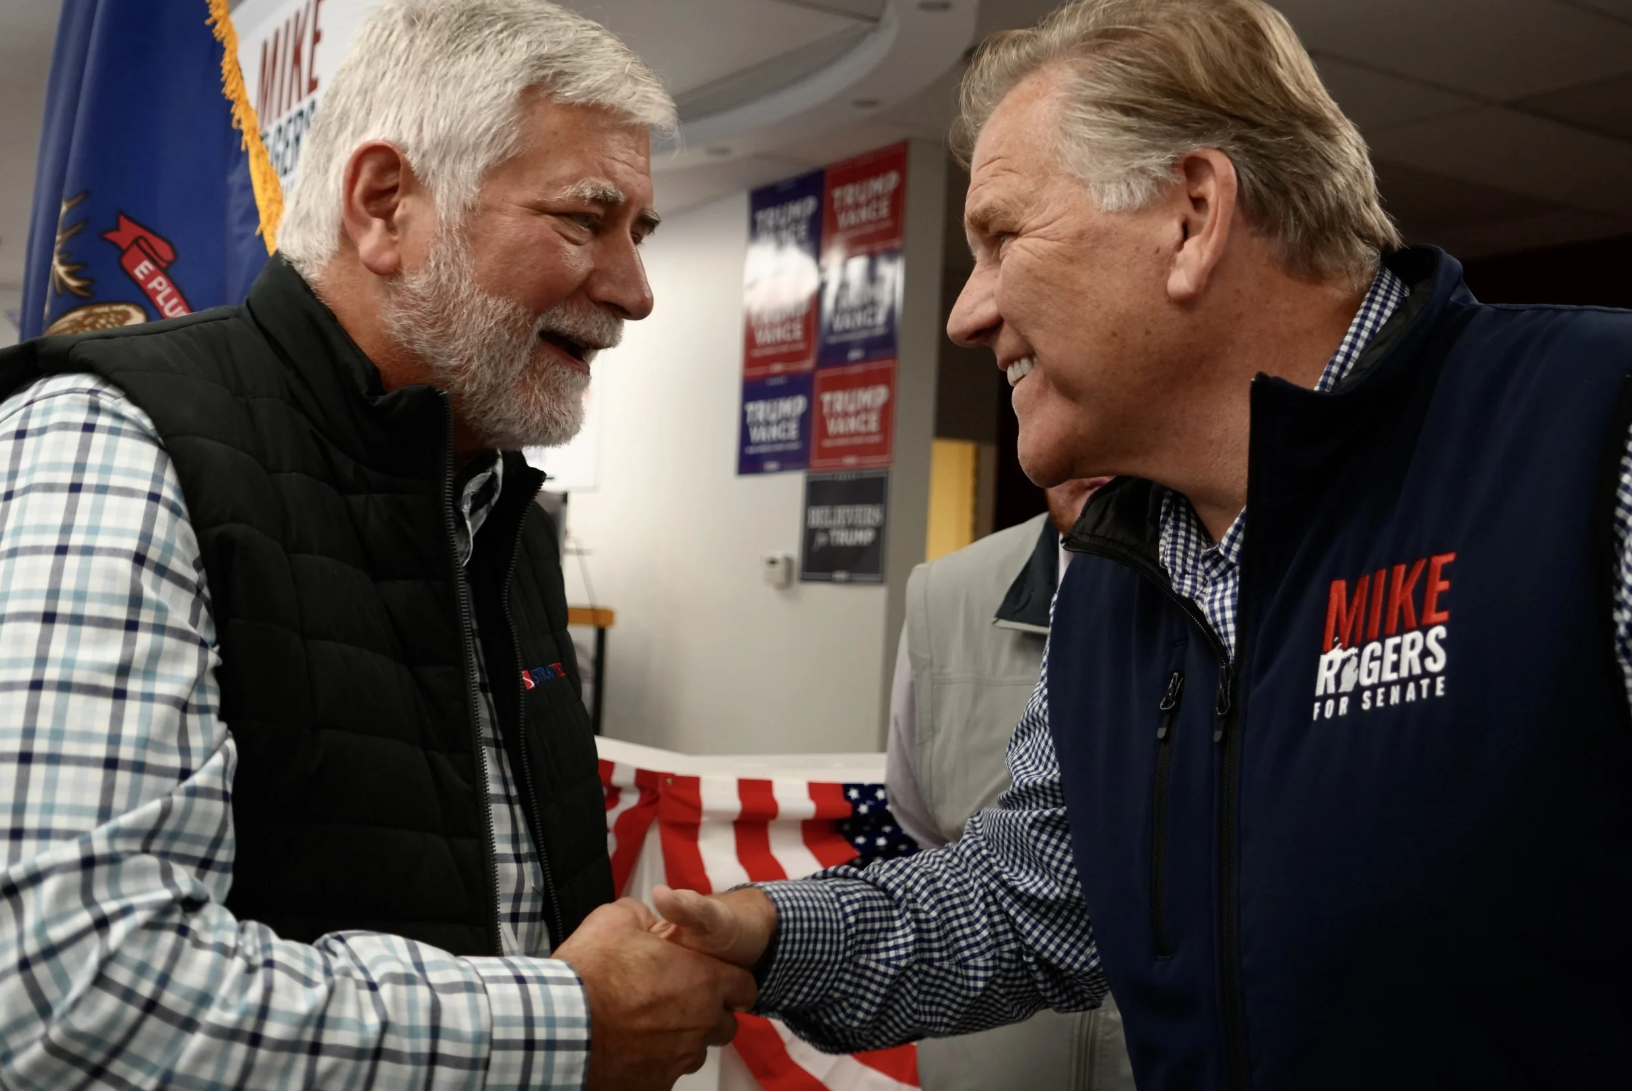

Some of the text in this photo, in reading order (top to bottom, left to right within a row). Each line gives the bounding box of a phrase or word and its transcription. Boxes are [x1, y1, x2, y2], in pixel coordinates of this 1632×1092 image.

[256, 0, 323, 131] MIKE
[832, 170, 900, 209] TRUMP
[754, 194, 818, 230] TRUMP
[836, 196, 890, 228] VANCE
[133, 260, 154, 281] E
[753, 320, 804, 345] VANCE
[744, 394, 807, 424] TRUMP
[820, 384, 889, 416] TRUMP
[749, 418, 800, 443] VANCE
[826, 410, 880, 436] VANCE
[829, 527, 876, 546] TRUMP
[1322, 551, 1457, 652] MIKE
[1315, 625, 1447, 697] RGERS
[1313, 676, 1446, 721] FOR SENATE
